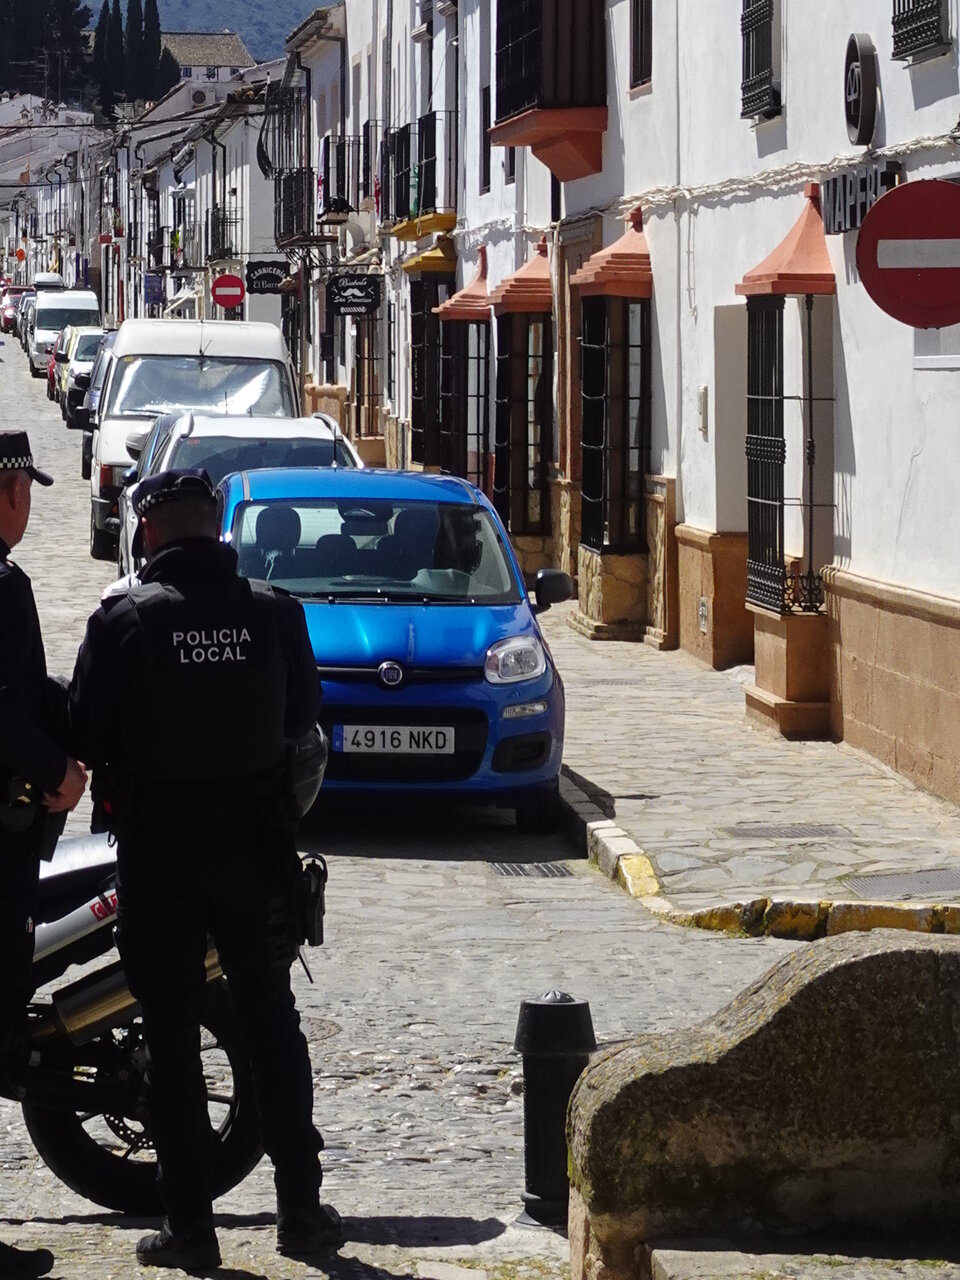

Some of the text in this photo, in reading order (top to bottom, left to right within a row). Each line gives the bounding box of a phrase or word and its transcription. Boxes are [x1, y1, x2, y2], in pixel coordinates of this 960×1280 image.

[333, 295, 346, 303] San
[173, 628, 251, 646] POLICIA
[180, 646, 246, 663] LOCAL
[351, 730, 447, 749] 4916 NKD
